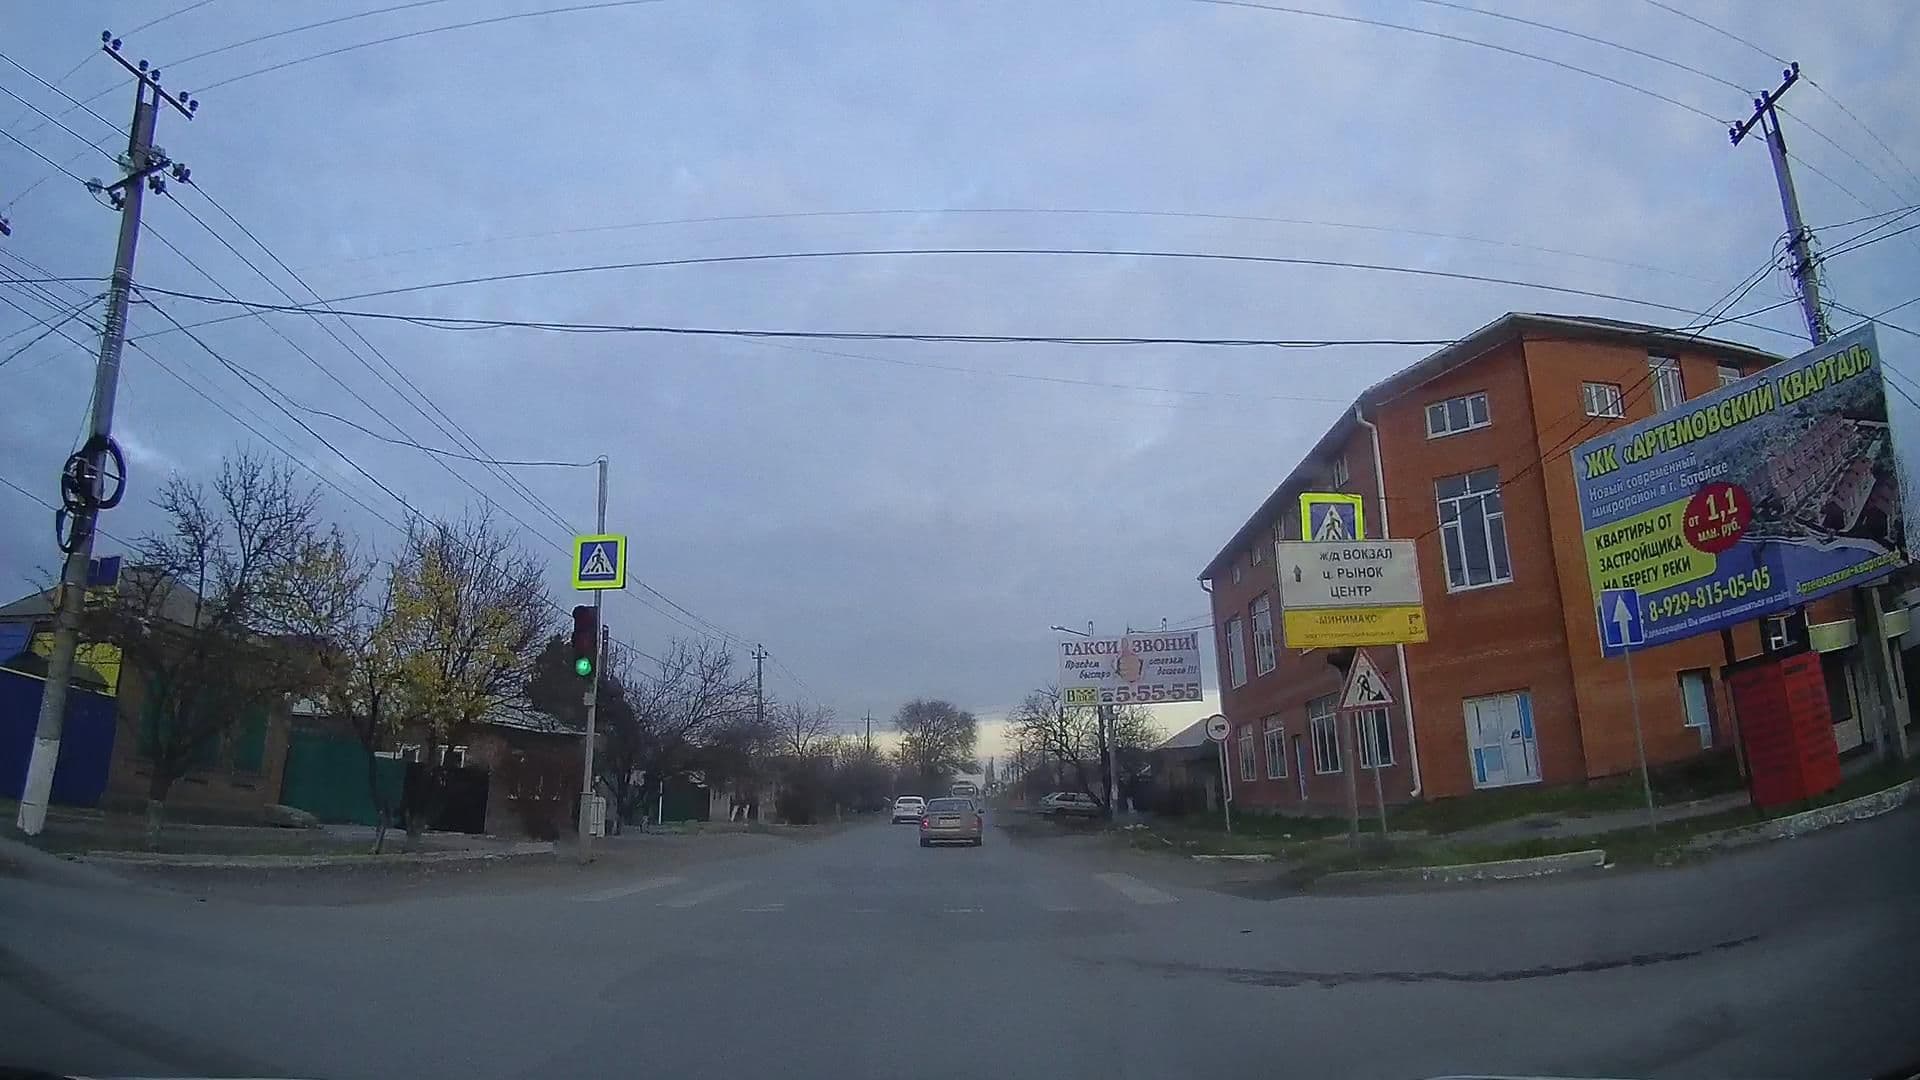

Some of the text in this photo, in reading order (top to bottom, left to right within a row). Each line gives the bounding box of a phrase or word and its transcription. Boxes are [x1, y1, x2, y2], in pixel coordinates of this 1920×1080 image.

[1584, 343, 1872, 480] ЖК «АРТЕМОВСКИЙ КВАРТАЛ»
[1589, 452, 1698, 501] Новый современный
[1592, 488, 1657, 518] микрорайон
[1680, 461, 1728, 488] Батайске
[1689, 487, 1738, 528] от 1,1
[1595, 513, 1672, 551] КВАРТИРЫ ОТ
[1698, 517, 1742, 542] млн. руб.
[1337, 566, 1384, 579] РЫНОК
[1343, 548, 1392, 560] ВОКЗАЛ
[1599, 534, 1683, 573] ЗАСТРОЙЩИКА
[1622, 567, 1658, 589] БЕРЕГУ
[1662, 556, 1692, 578] РЕКИ
[1330, 585, 1372, 599] ЦЕНТР
[1649, 565, 1770, 622] 8-929-815-05-05
[1062, 634, 1198, 656] ТАКСИ ЗВОНИ!
